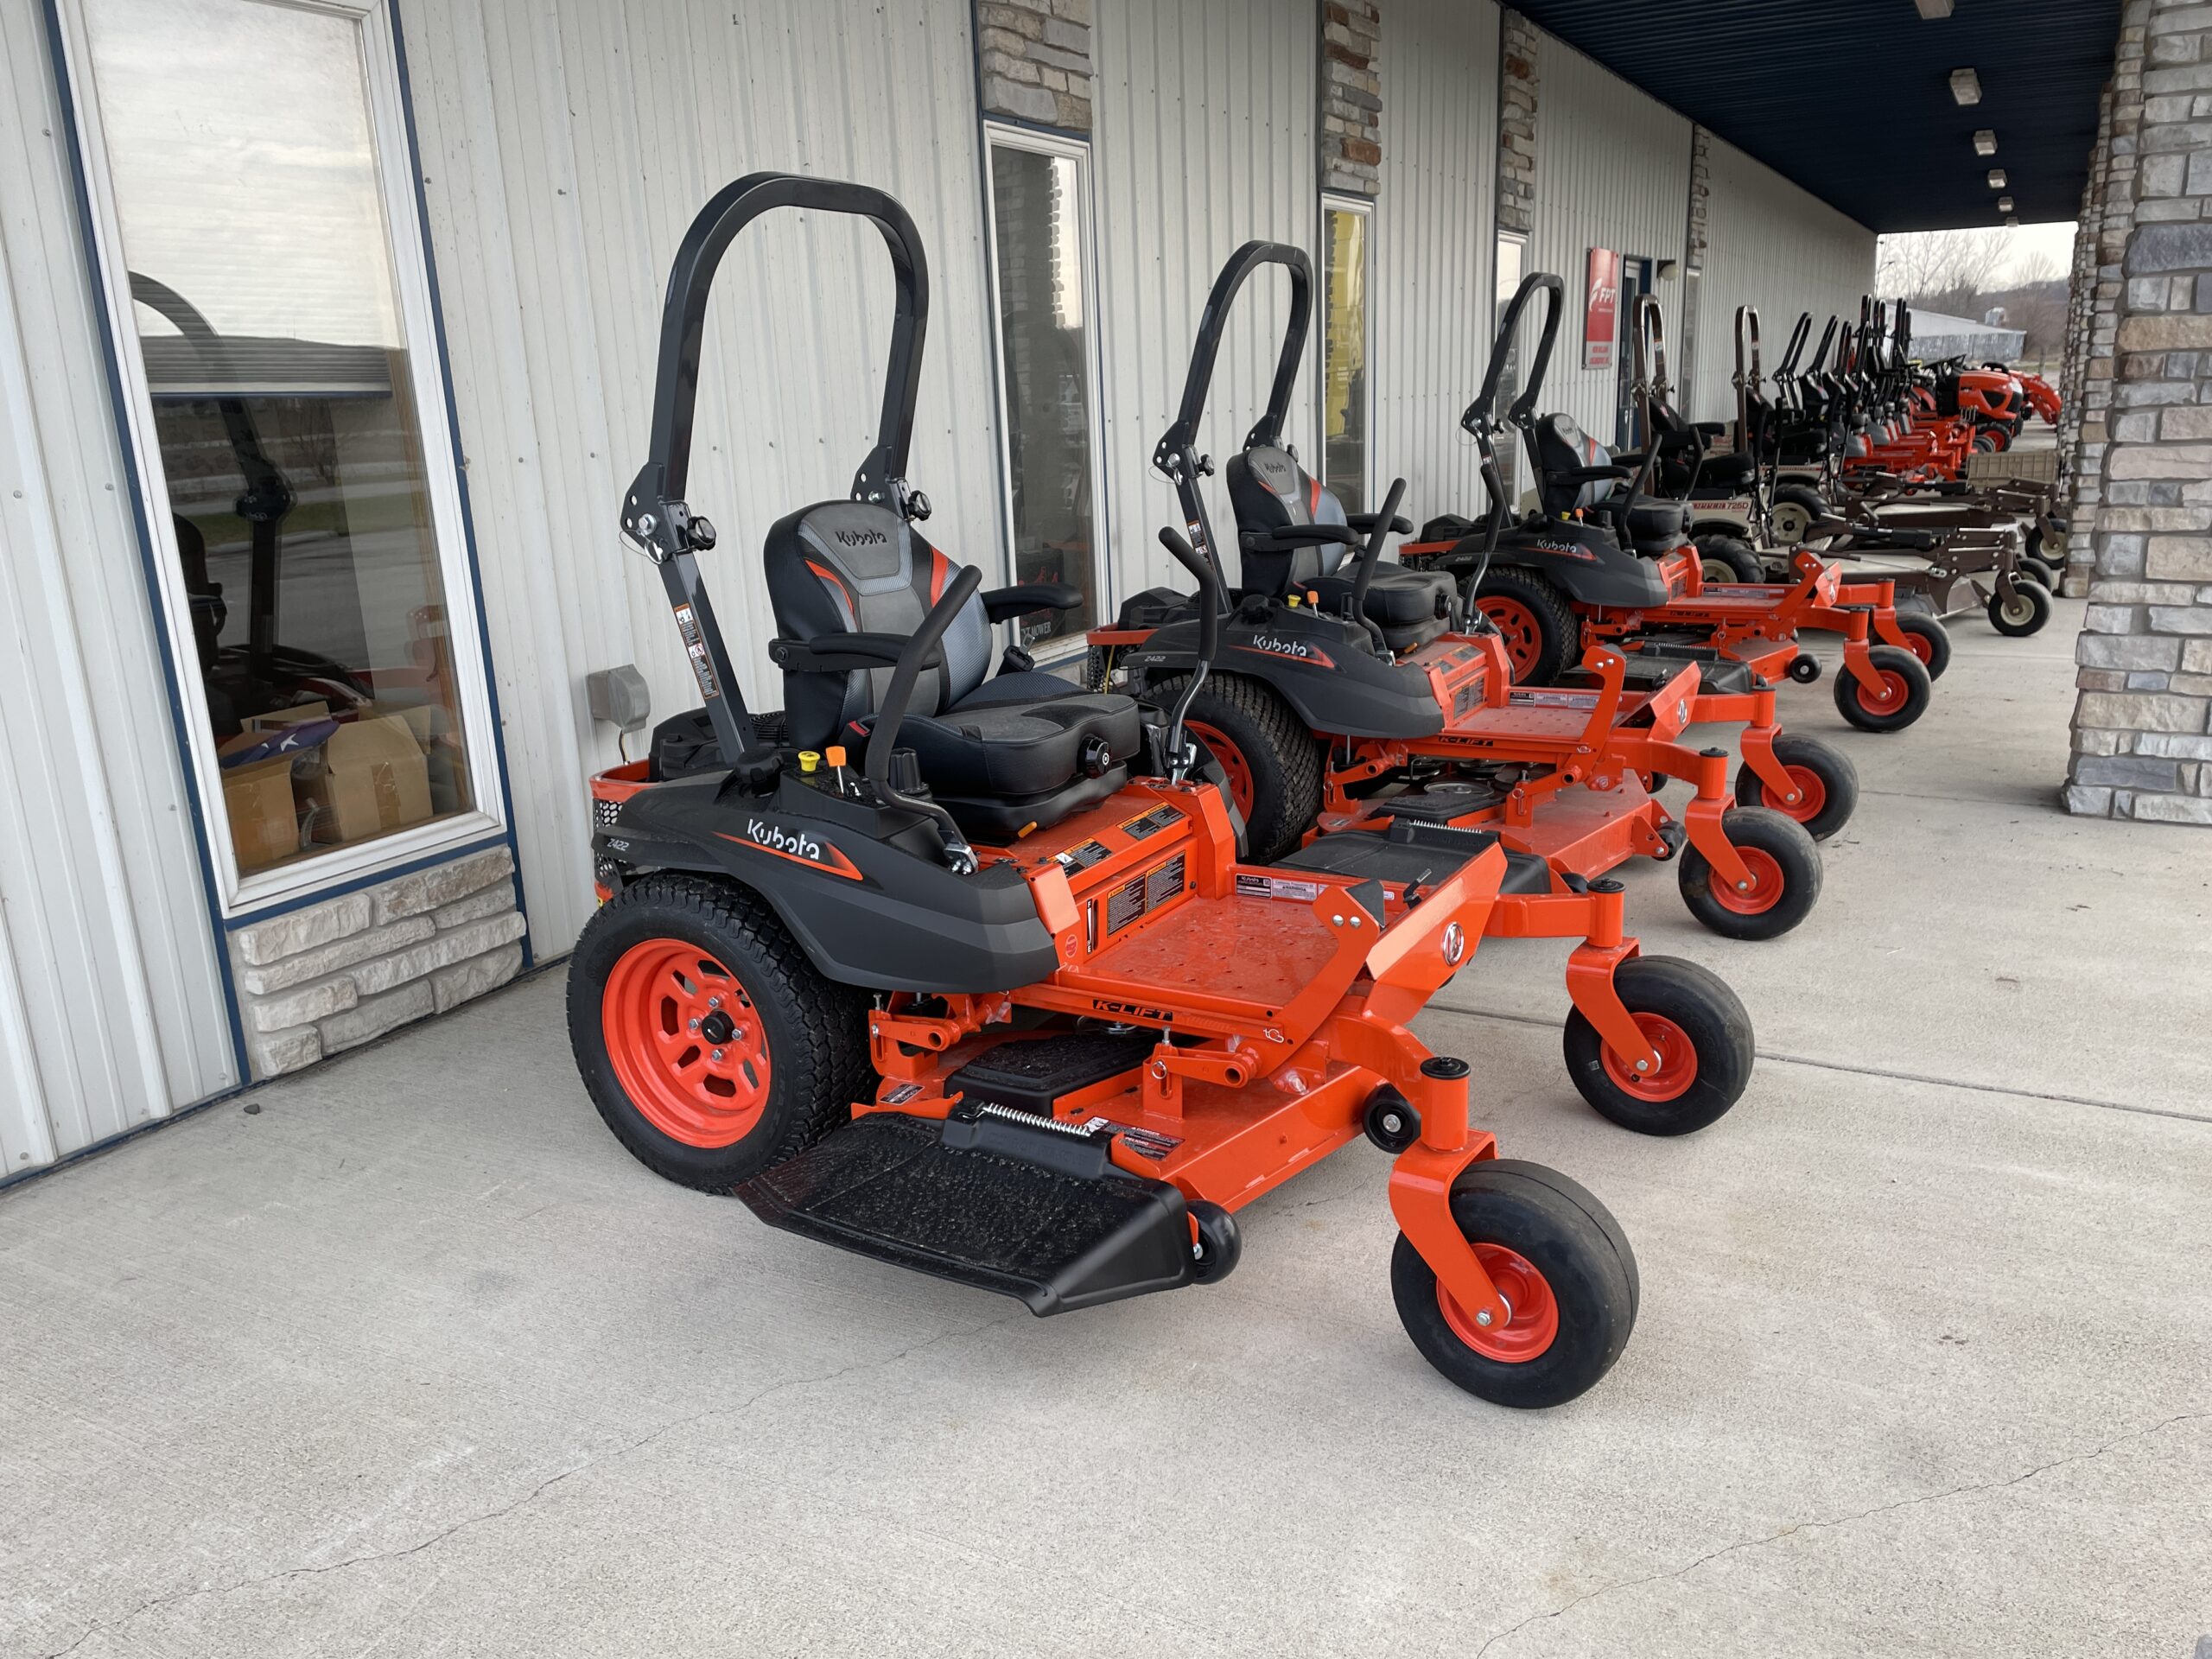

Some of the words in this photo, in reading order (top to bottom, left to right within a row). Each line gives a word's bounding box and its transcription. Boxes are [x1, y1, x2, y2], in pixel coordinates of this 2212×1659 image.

[1599, 287, 1616, 303] FPT
[835, 529, 887, 547] Kubota
[1537, 538, 1577, 553] Kubota
[1031, 621, 1052, 637] MOWER
[1253, 634, 1307, 657] Kubota
[607, 837, 629, 852] Z422
[747, 818, 821, 860] Kubota
[1096, 1000, 1172, 1020] K-LIFT
